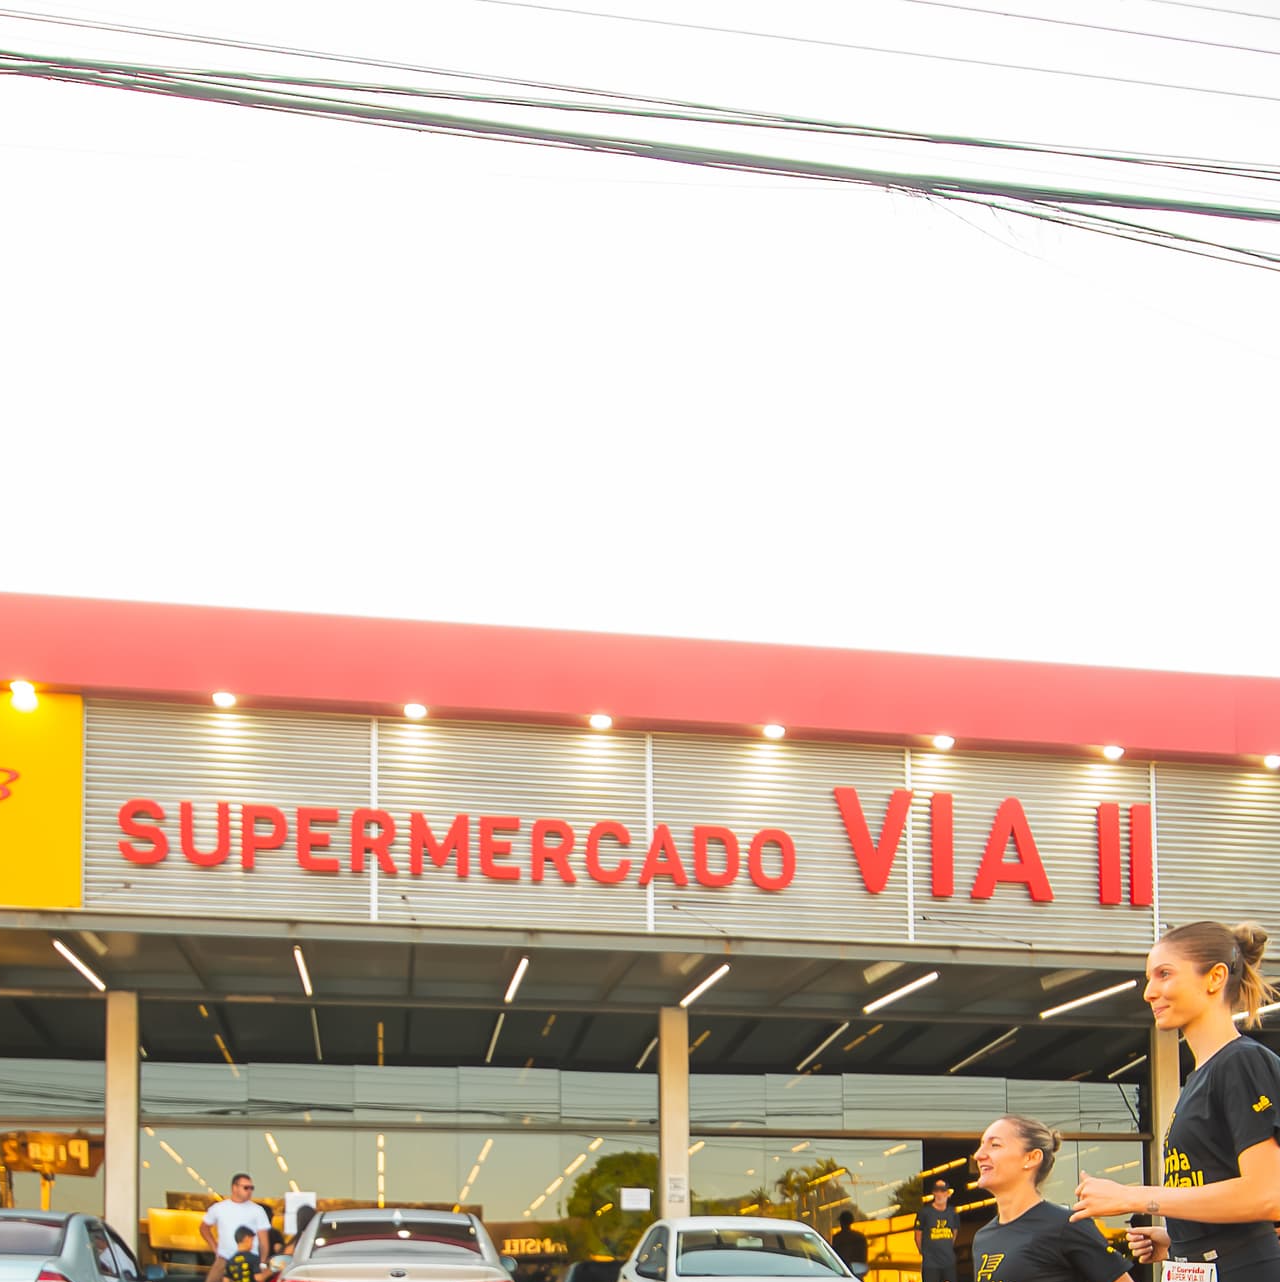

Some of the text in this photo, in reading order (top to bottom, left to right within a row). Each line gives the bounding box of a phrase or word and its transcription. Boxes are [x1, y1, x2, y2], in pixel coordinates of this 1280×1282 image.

[118, 786, 1154, 906] SUPERMERCADO VIA II
